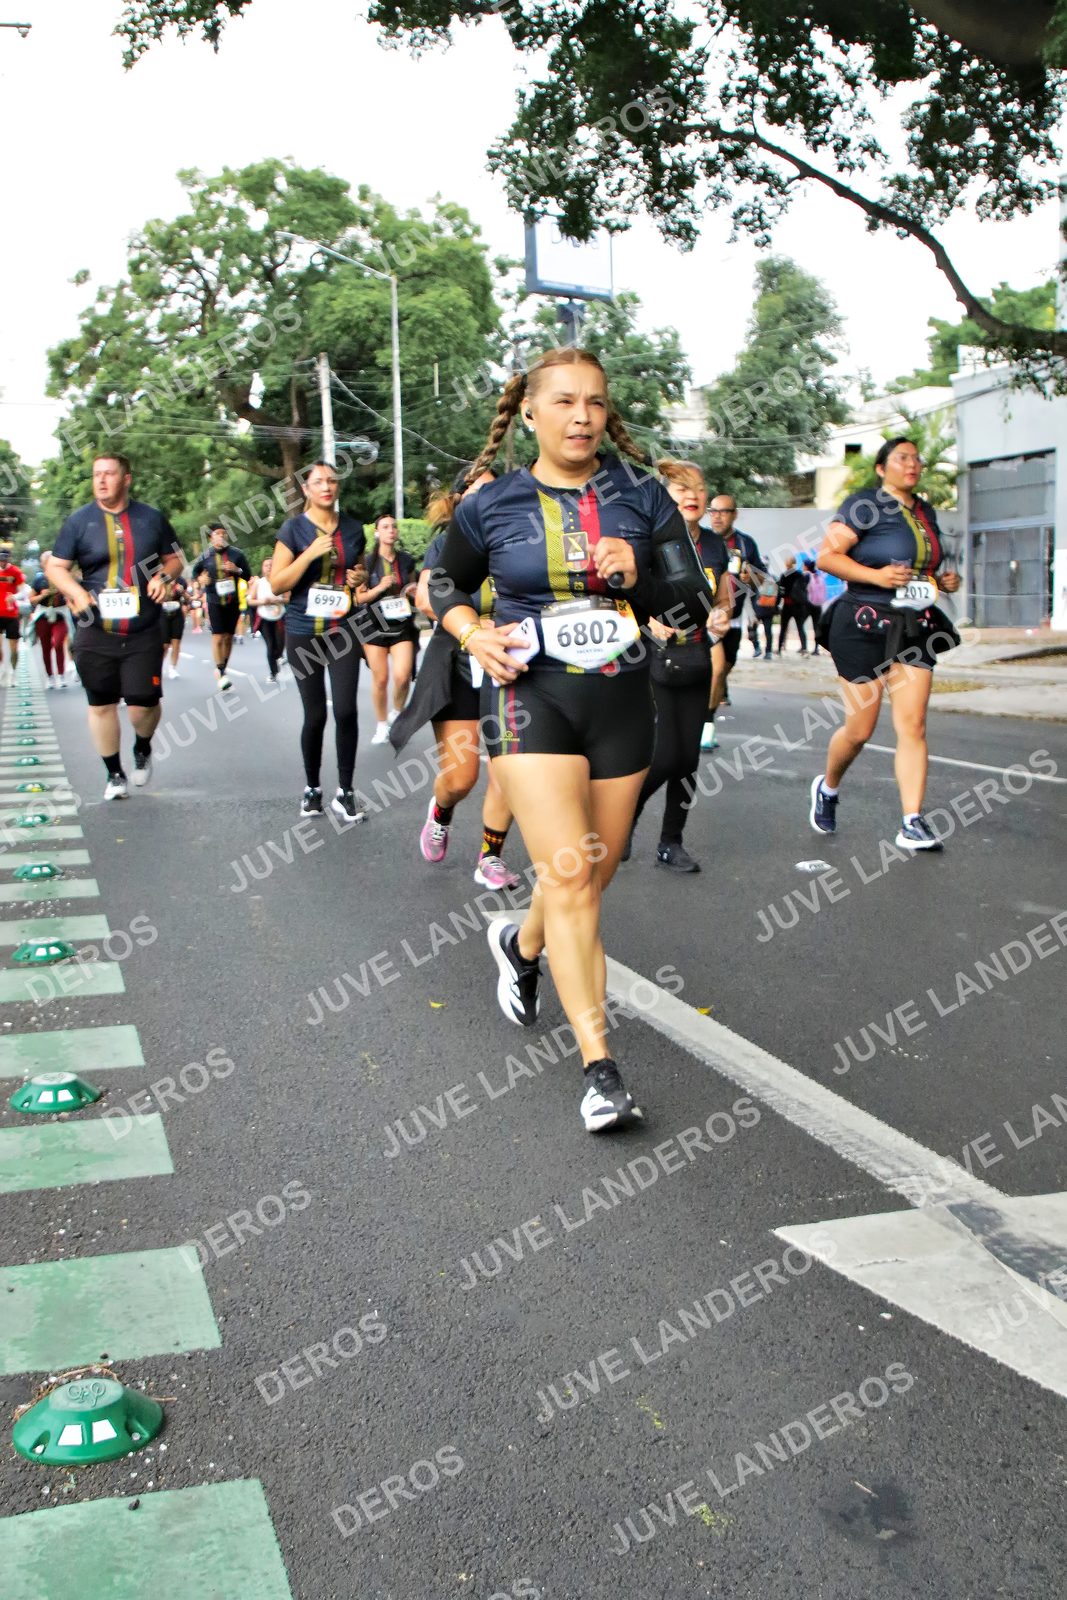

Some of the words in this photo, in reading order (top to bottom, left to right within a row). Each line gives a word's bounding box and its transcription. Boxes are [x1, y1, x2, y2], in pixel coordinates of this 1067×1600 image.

[904, 586, 929, 599] 2012
[105, 596, 130, 607] 3914
[314, 594, 343, 606] 6997
[557, 619, 620, 647] 6802
